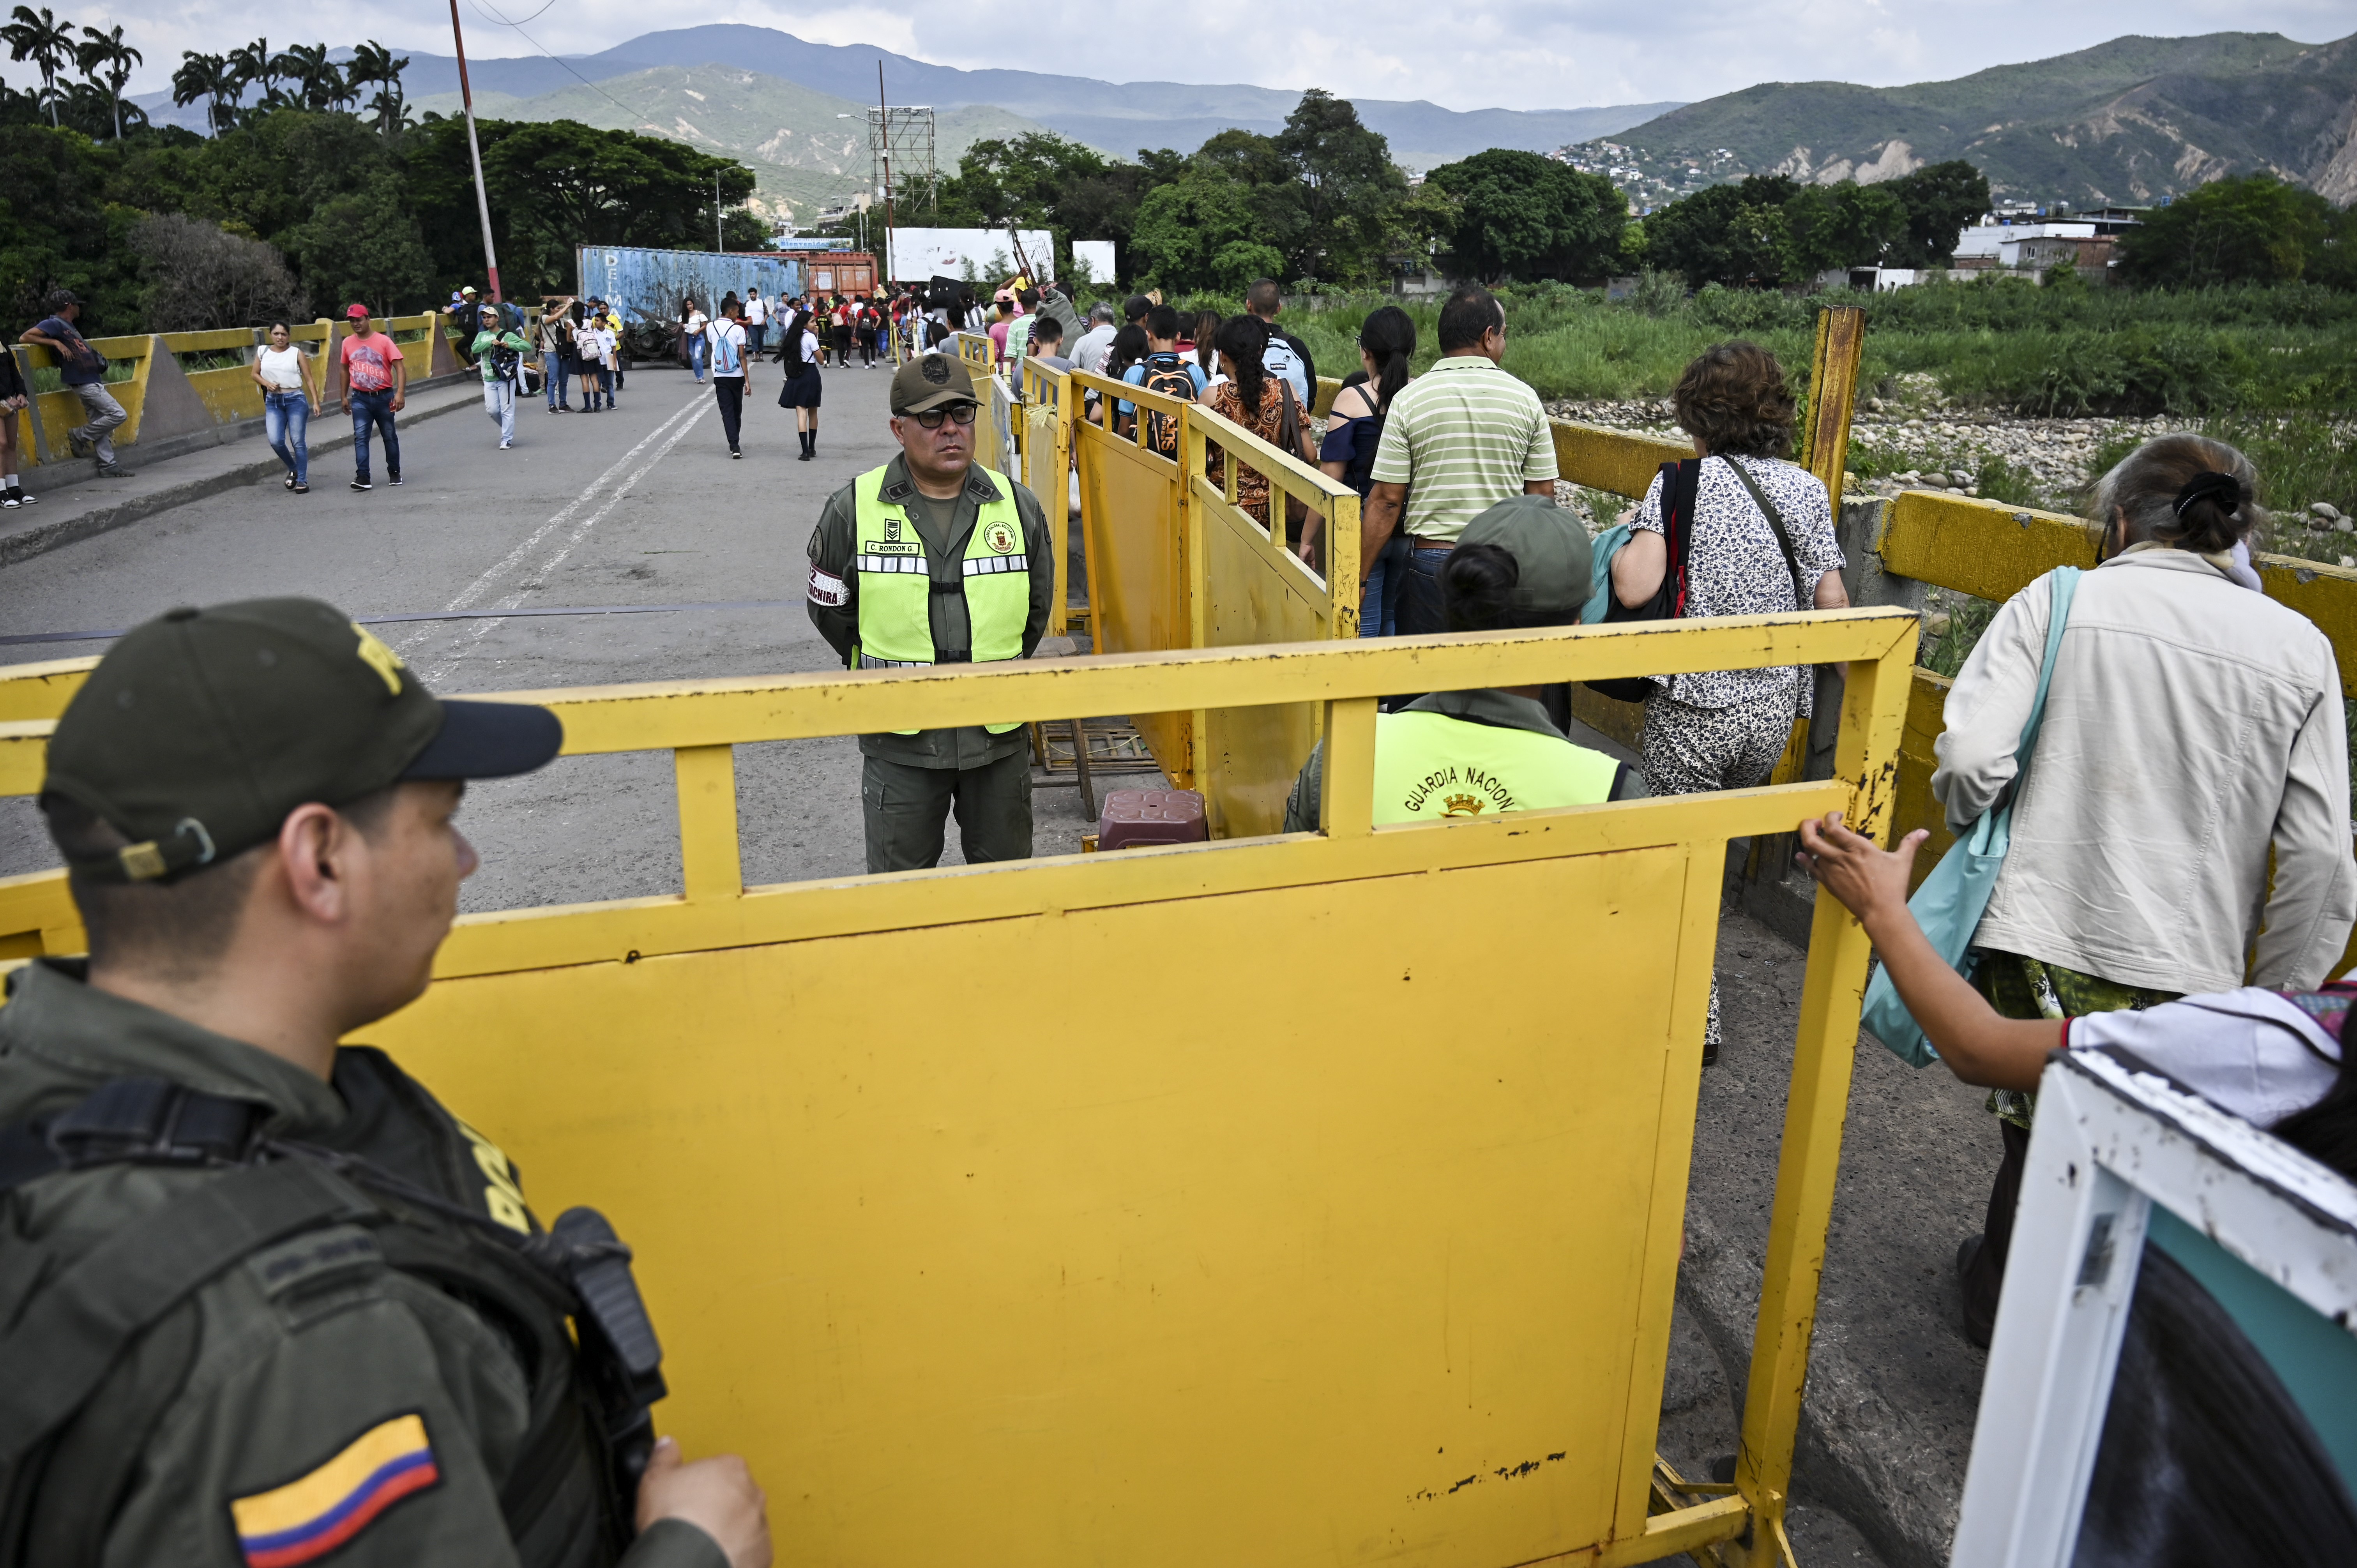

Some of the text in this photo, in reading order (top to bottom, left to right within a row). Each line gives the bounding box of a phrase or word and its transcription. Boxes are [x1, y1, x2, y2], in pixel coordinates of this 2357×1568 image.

[605, 255, 622, 320] DELMA
[808, 581, 837, 604] TACHIRA
[1404, 766, 1518, 813] GUARDIA NACION
